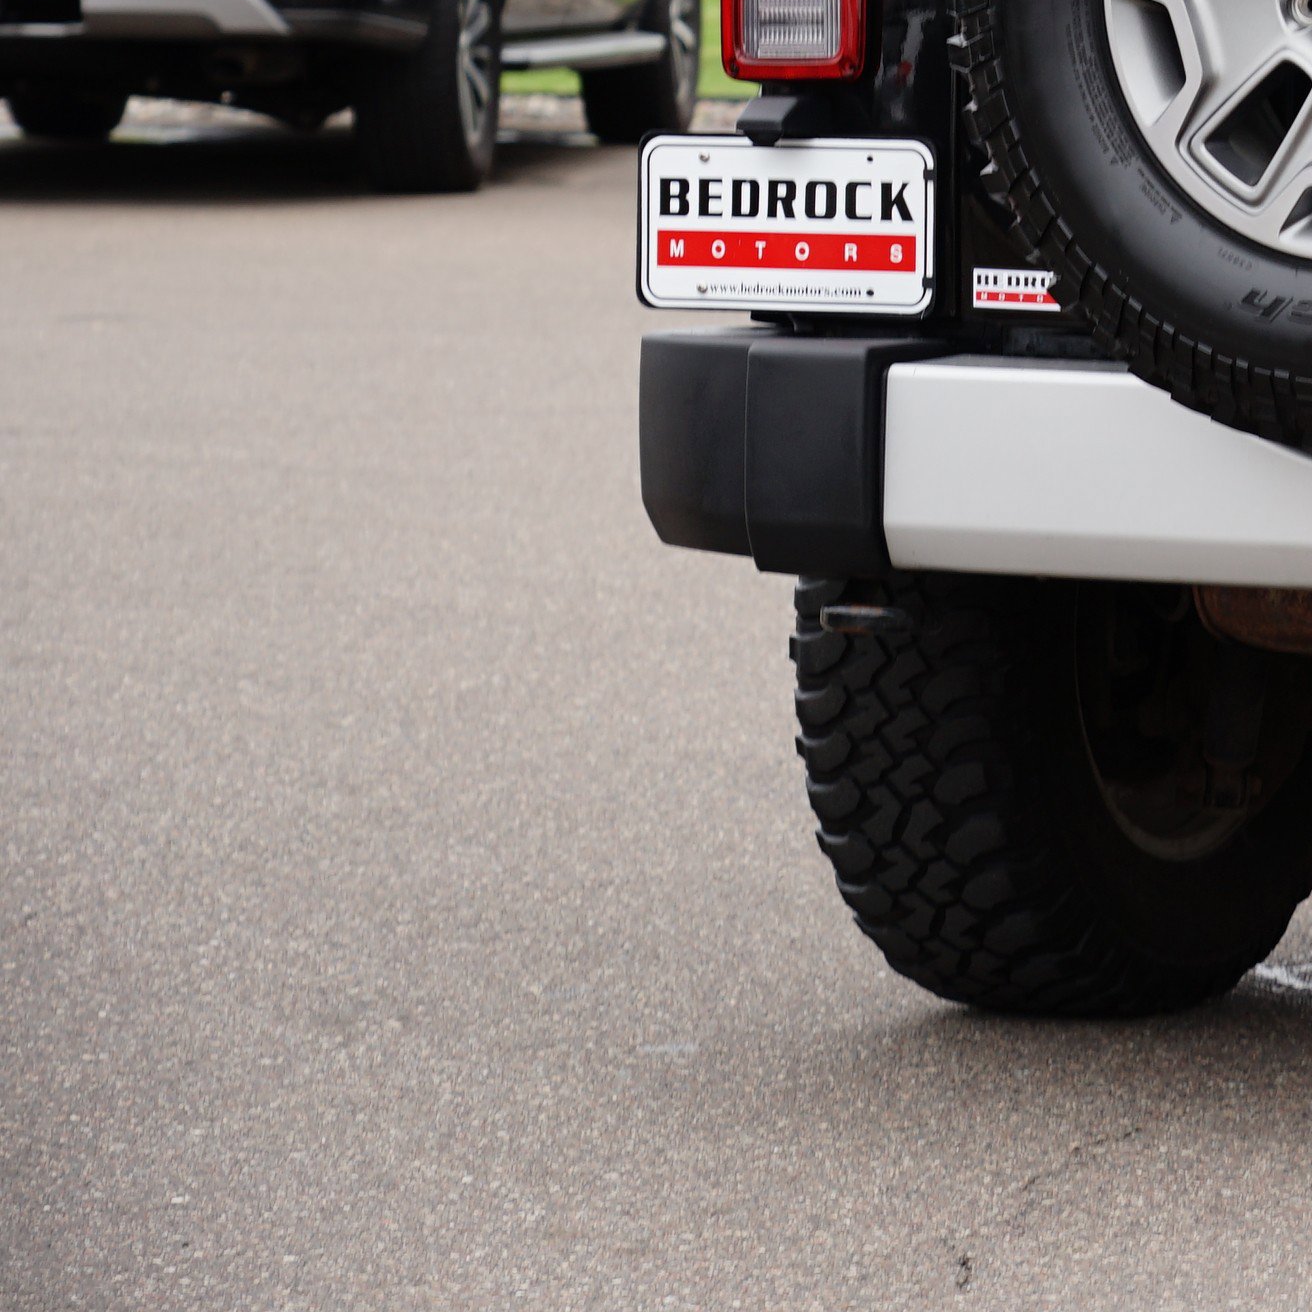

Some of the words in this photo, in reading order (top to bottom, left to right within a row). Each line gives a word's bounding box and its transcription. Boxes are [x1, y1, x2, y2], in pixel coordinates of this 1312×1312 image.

[658, 178, 914, 222] BEDROCK
[669, 238, 904, 263] MOTORS
[710, 280, 862, 299] www.bedrockmotors.com
